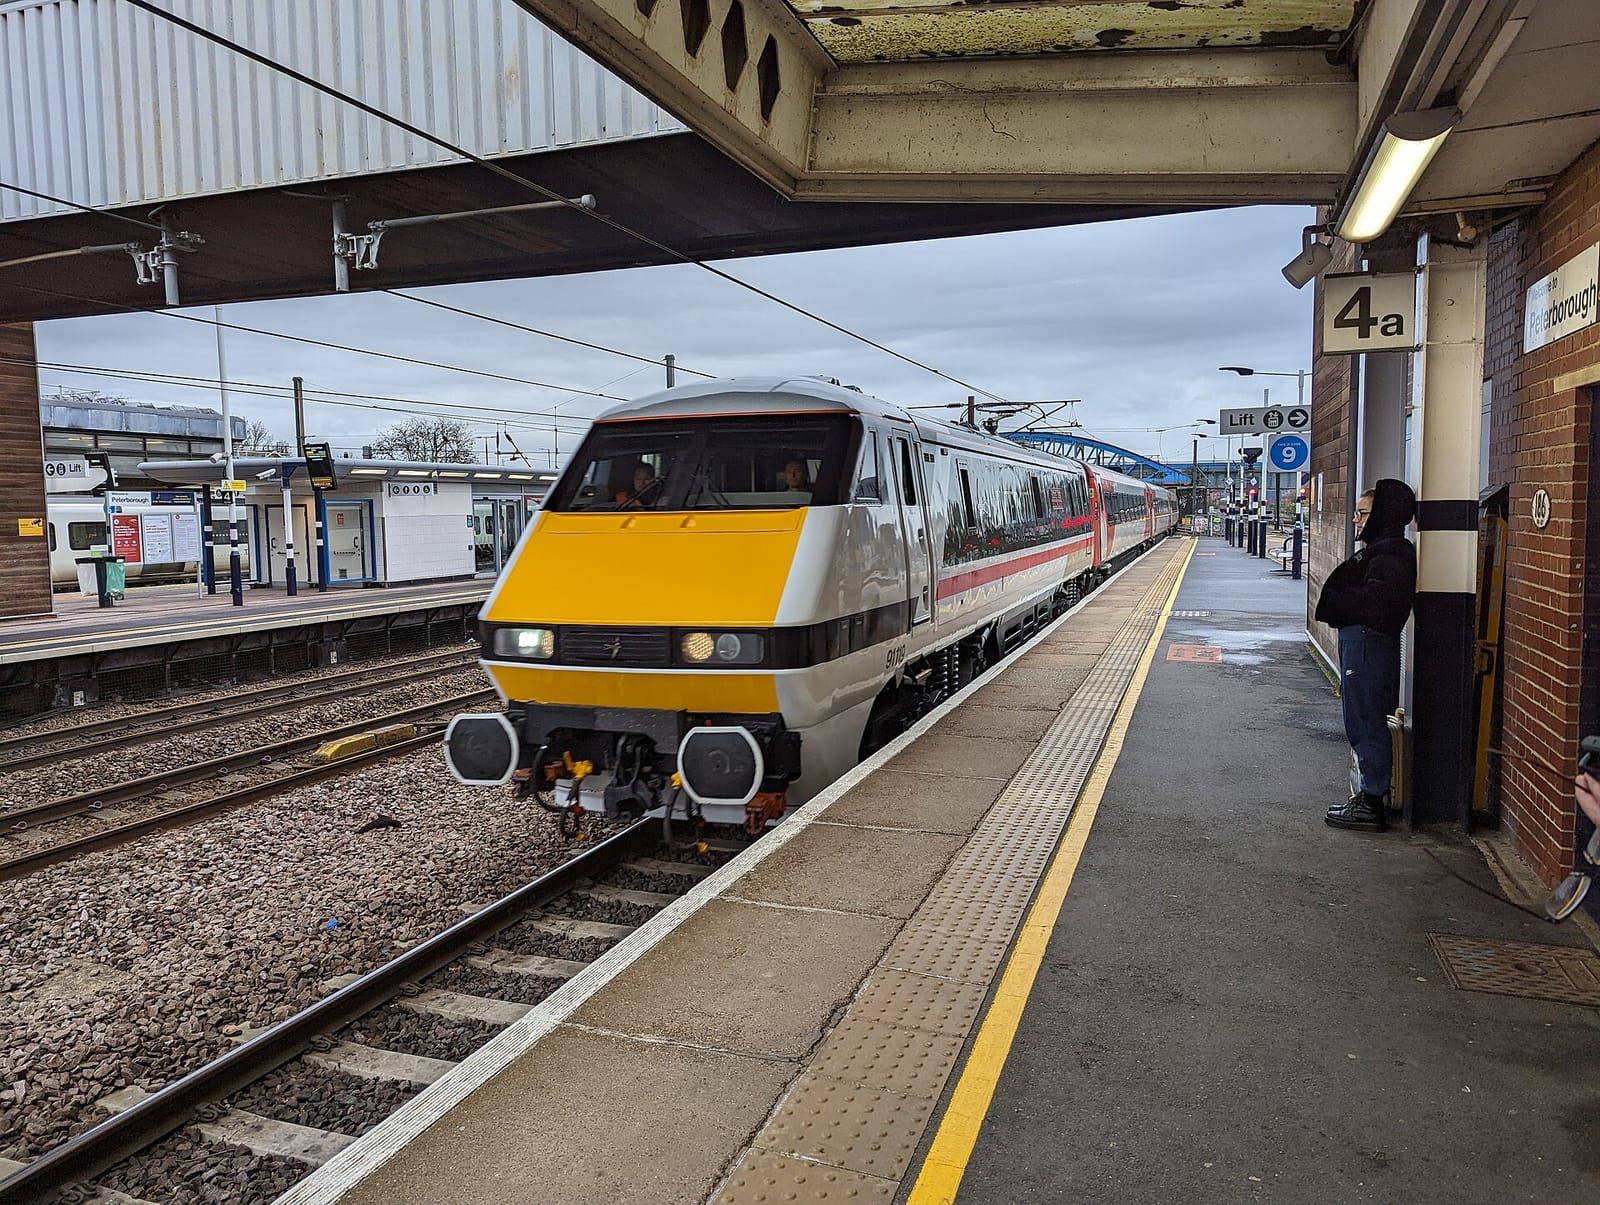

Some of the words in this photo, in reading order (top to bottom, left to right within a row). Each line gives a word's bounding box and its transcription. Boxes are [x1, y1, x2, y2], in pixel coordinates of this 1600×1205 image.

[1530, 280, 1552, 301] Welcome
[1552, 276, 1558, 289] to
[1333, 286, 1404, 339] 4a
[1528, 278, 1597, 338] Peterborough
[1229, 413, 1255, 427] Lift
[1282, 446, 1296, 464] 9
[68, 463, 82, 473] Lift
[111, 496, 149, 504] Peterborough
[223, 492, 231, 501] 4
[1534, 493, 1547, 519] 186
